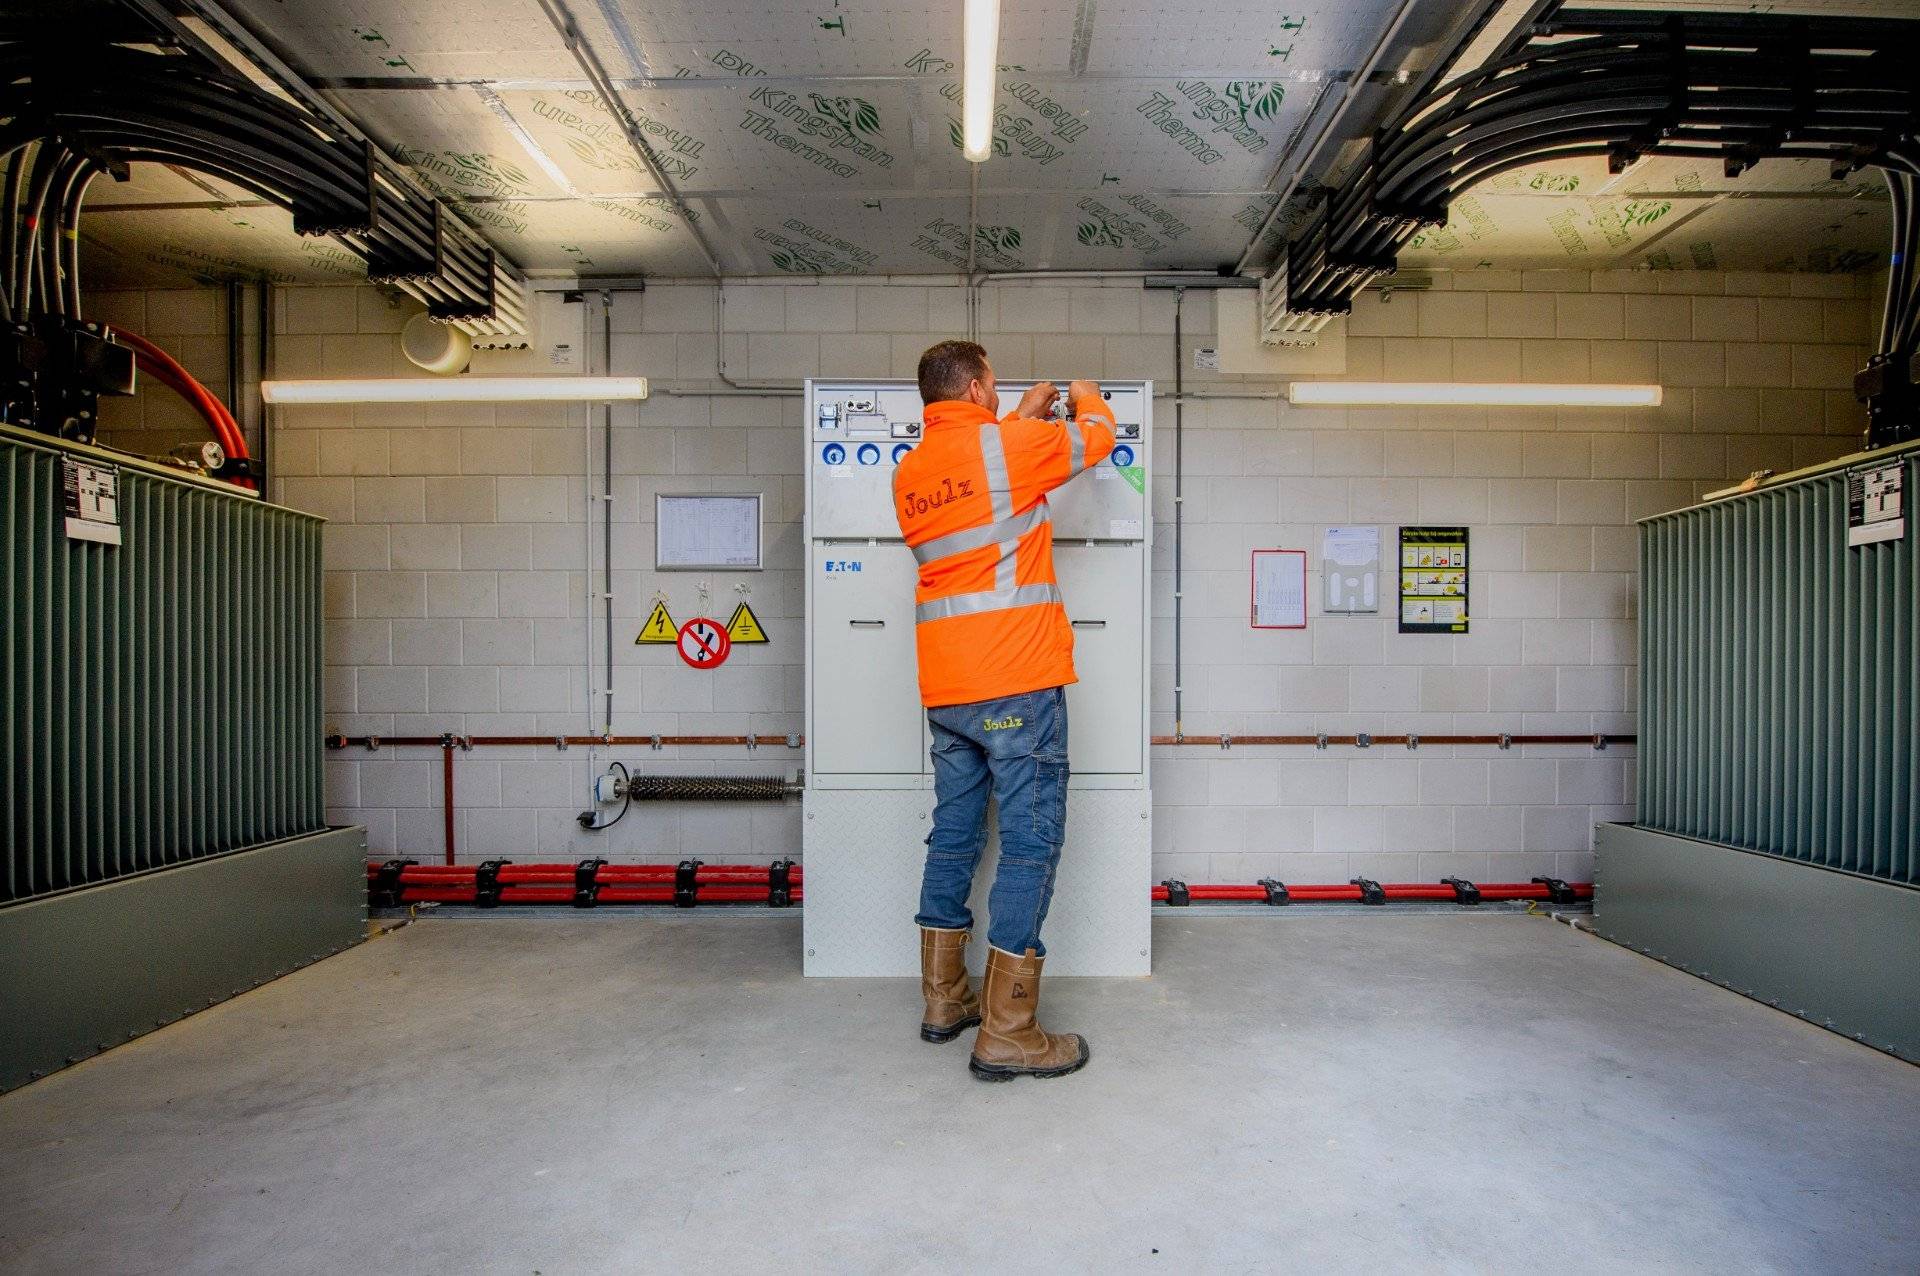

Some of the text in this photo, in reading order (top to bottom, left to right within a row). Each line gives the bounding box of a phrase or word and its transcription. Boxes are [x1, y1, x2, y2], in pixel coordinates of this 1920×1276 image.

[740, 109, 858, 178] Therma
[750, 86, 895, 168] Kingspan
[1136, 90, 1223, 166] Therma
[904, 477, 974, 518] Joulz
[983, 715, 1024, 731] Joulz
